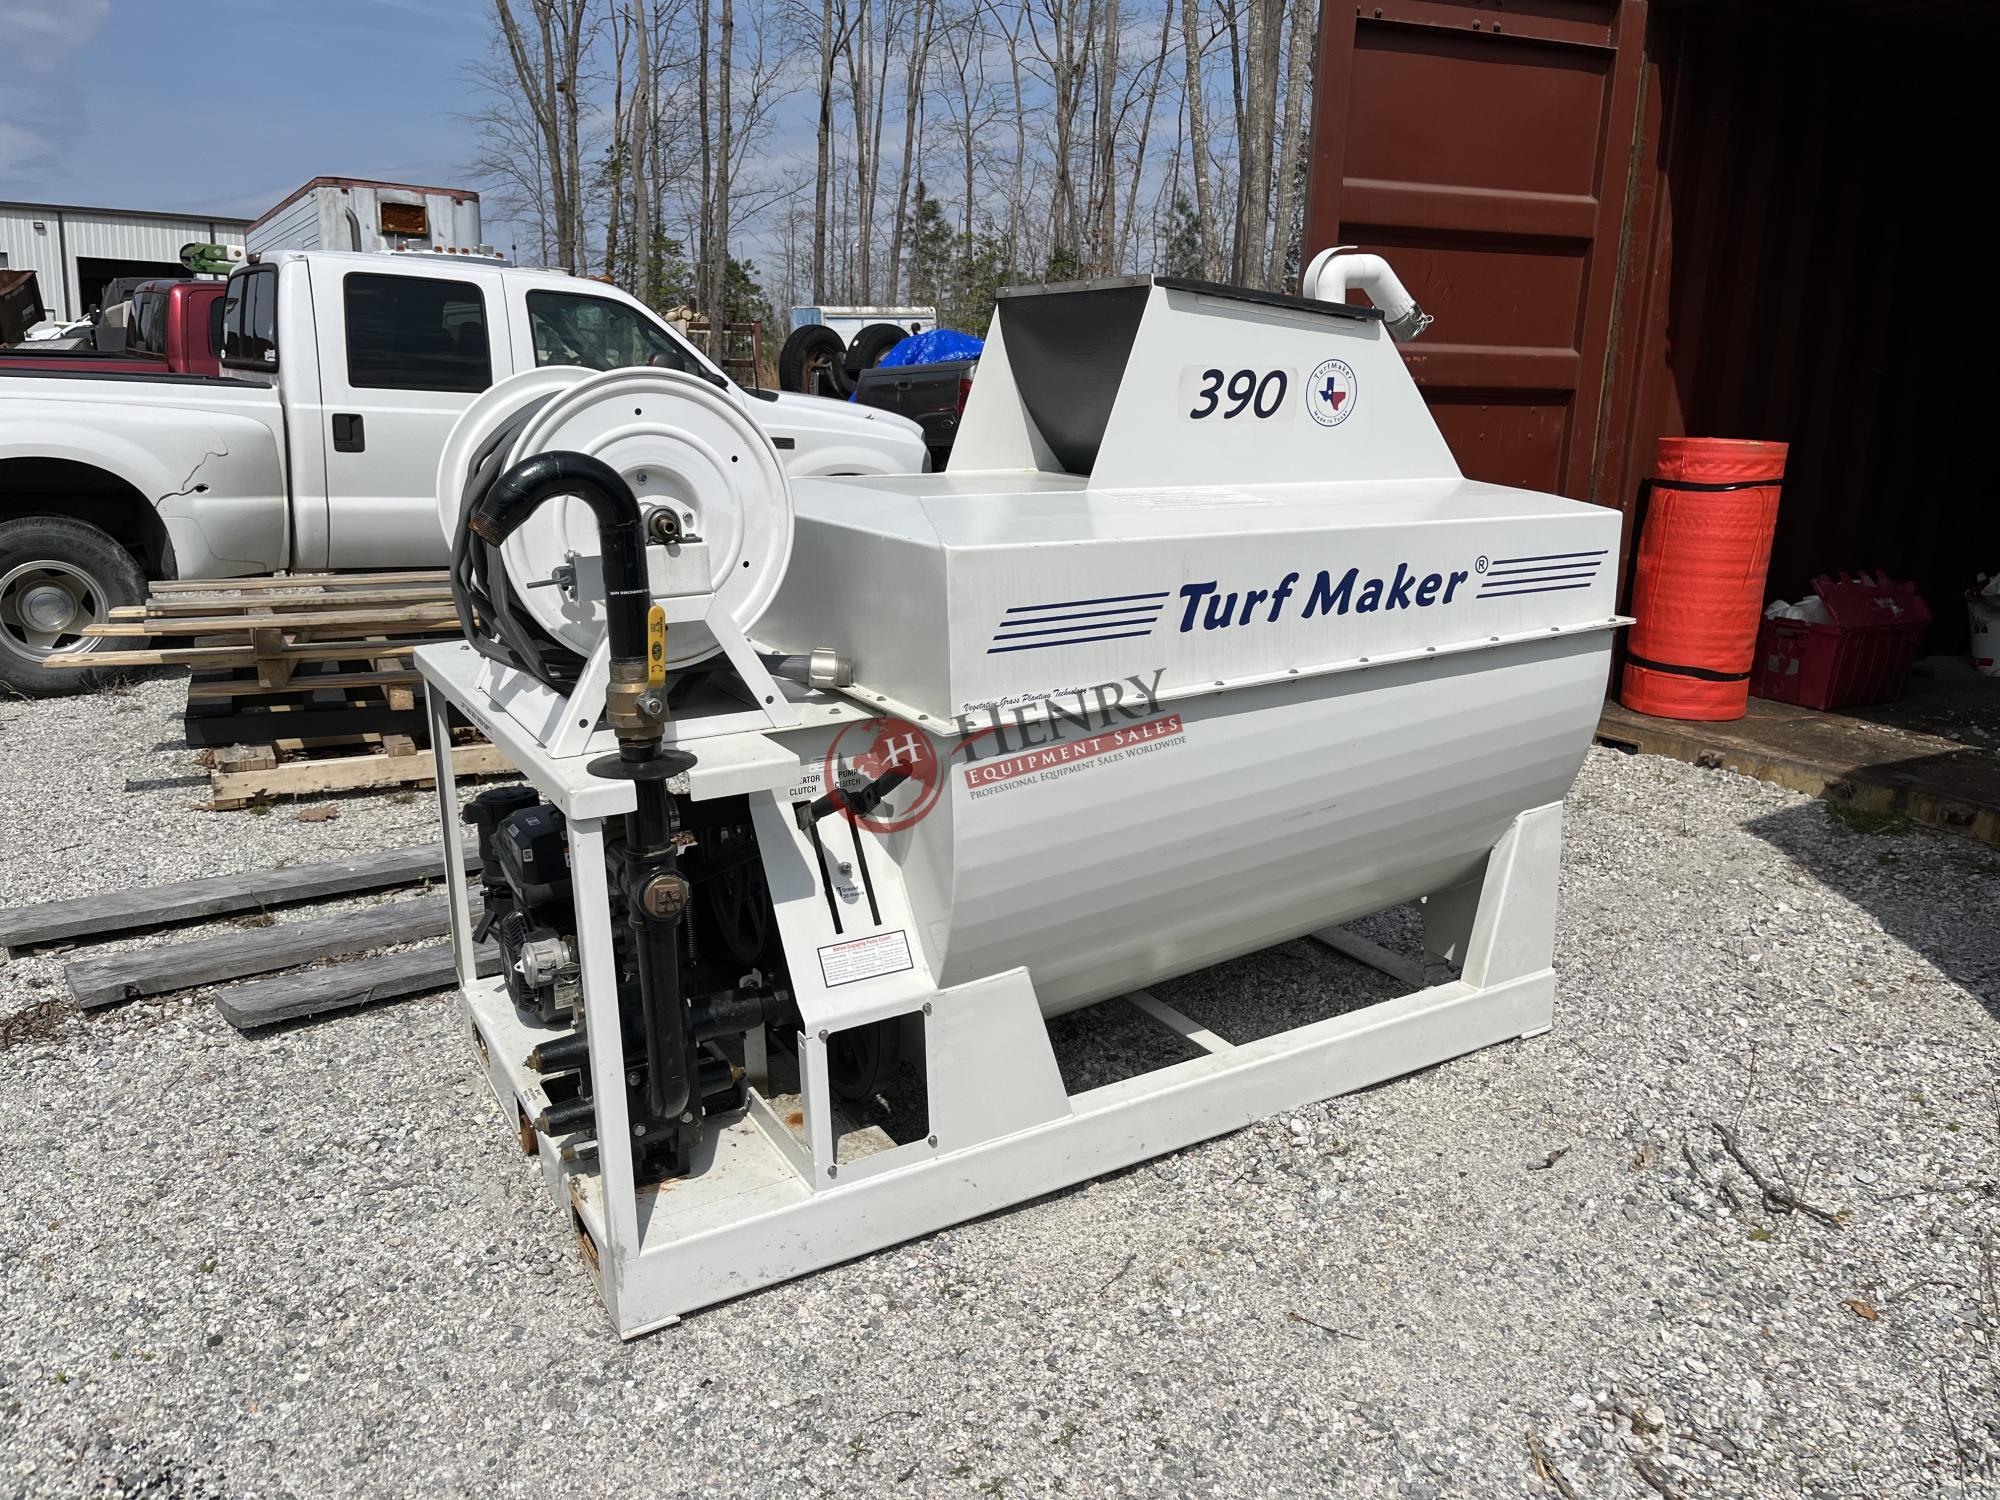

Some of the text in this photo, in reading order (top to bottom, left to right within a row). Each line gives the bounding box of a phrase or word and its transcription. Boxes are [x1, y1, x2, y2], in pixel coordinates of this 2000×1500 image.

[1313, 362, 1352, 380] TurfMaker
[1189, 368, 1288, 420] 390
[1178, 571, 1300, 633] Turf
[1301, 562, 1468, 619] Maker
[1000, 697, 1020, 708] Grass
[1022, 692, 1051, 702] Planting
[1053, 687, 1087, 698] Technology
[800, 774, 820, 785] ATOR
[838, 768, 858, 778] PUMP
[834, 778, 861, 788] CLUTCH
[789, 785, 817, 796] CLUTCH
